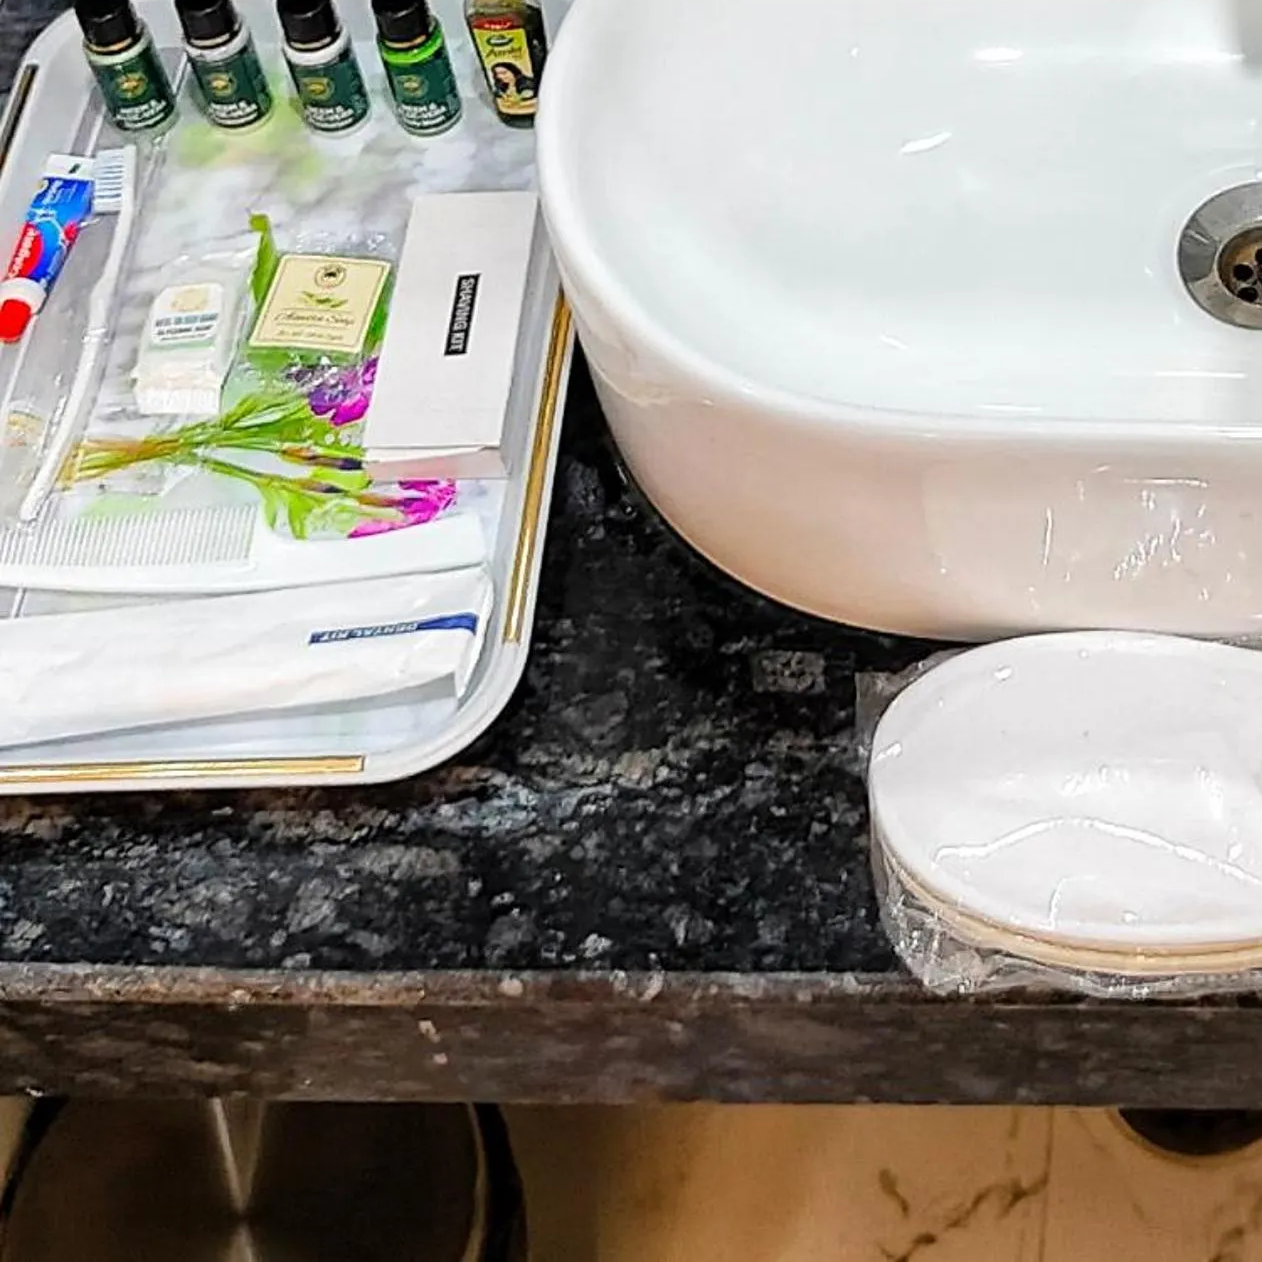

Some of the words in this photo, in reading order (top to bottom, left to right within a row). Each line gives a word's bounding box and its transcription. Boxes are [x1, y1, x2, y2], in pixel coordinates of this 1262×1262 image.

[453, 278, 475, 331] SHAVING
[448, 331, 465, 352] KIT
[320, 629, 349, 641] KIT
[351, 622, 418, 638] DENTAL
